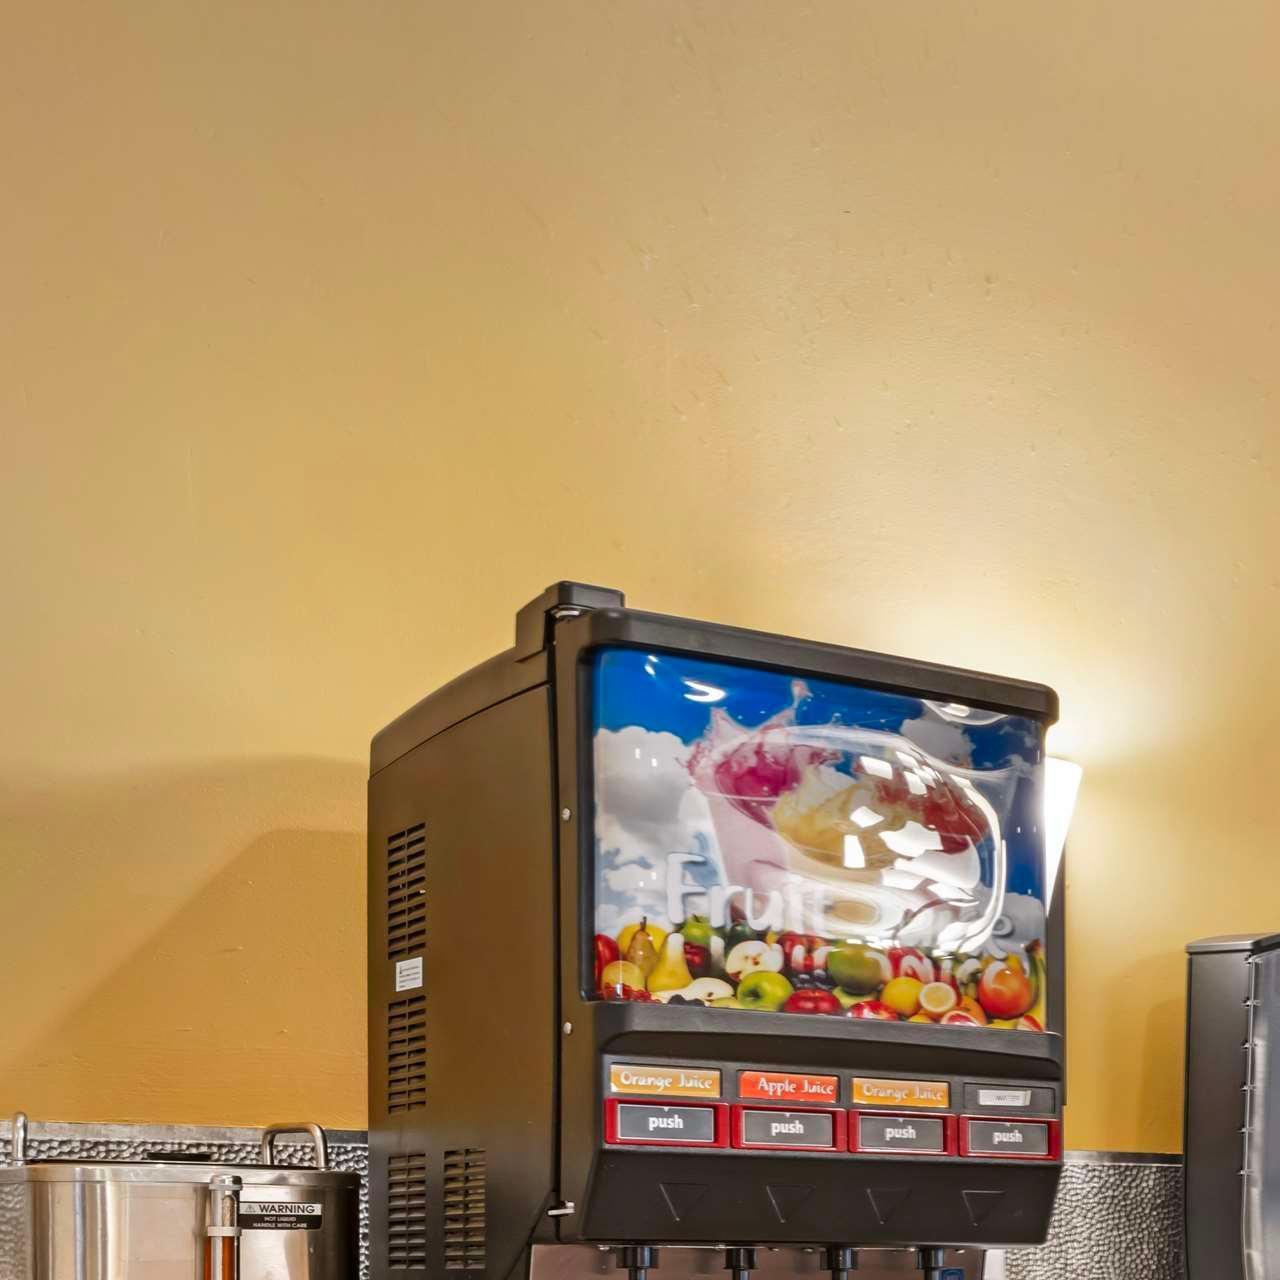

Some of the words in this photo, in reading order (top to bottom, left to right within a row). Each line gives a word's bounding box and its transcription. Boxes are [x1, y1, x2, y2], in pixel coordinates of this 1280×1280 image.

[620, 1071, 672, 1092] Orange
[679, 1073, 712, 1089] Juice
[758, 1077, 796, 1096] Apple
[801, 1081, 834, 1095] Juice
[862, 1083, 908, 1102] Orange
[913, 1085, 944, 1101] Juice
[648, 1114, 684, 1132] push
[771, 1119, 805, 1137] push
[885, 1125, 917, 1141] push
[993, 1130, 1023, 1145] push
[259, 1204, 315, 1214] WARNING
